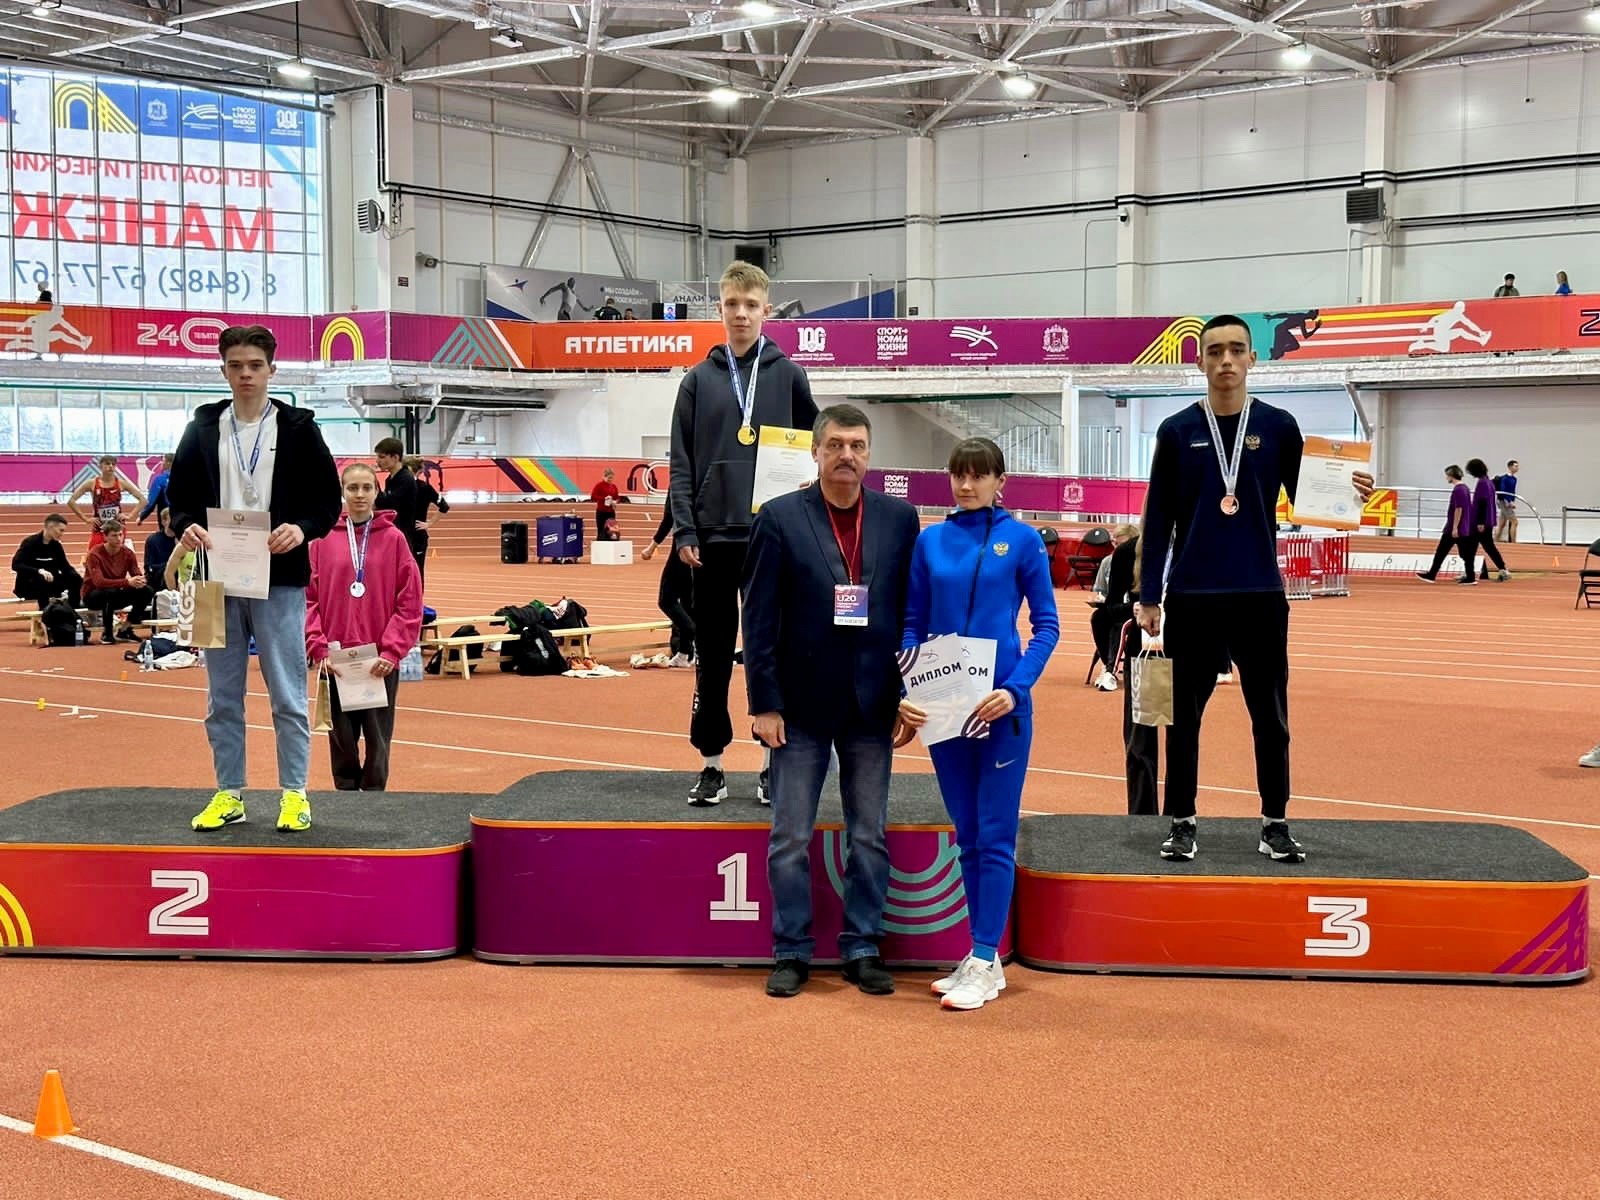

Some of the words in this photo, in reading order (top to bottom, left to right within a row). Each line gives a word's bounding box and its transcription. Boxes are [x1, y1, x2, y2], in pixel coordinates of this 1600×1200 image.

[565, 335, 693, 354] АТЛЕТИКА
[1387, 555, 1393, 564] 6
[837, 594, 857, 602] U20
[910, 661, 962, 688] ДИПЛОМ
[710, 853, 759, 920] 1
[149, 870, 208, 935] 2
[1305, 896, 1370, 957] 3
